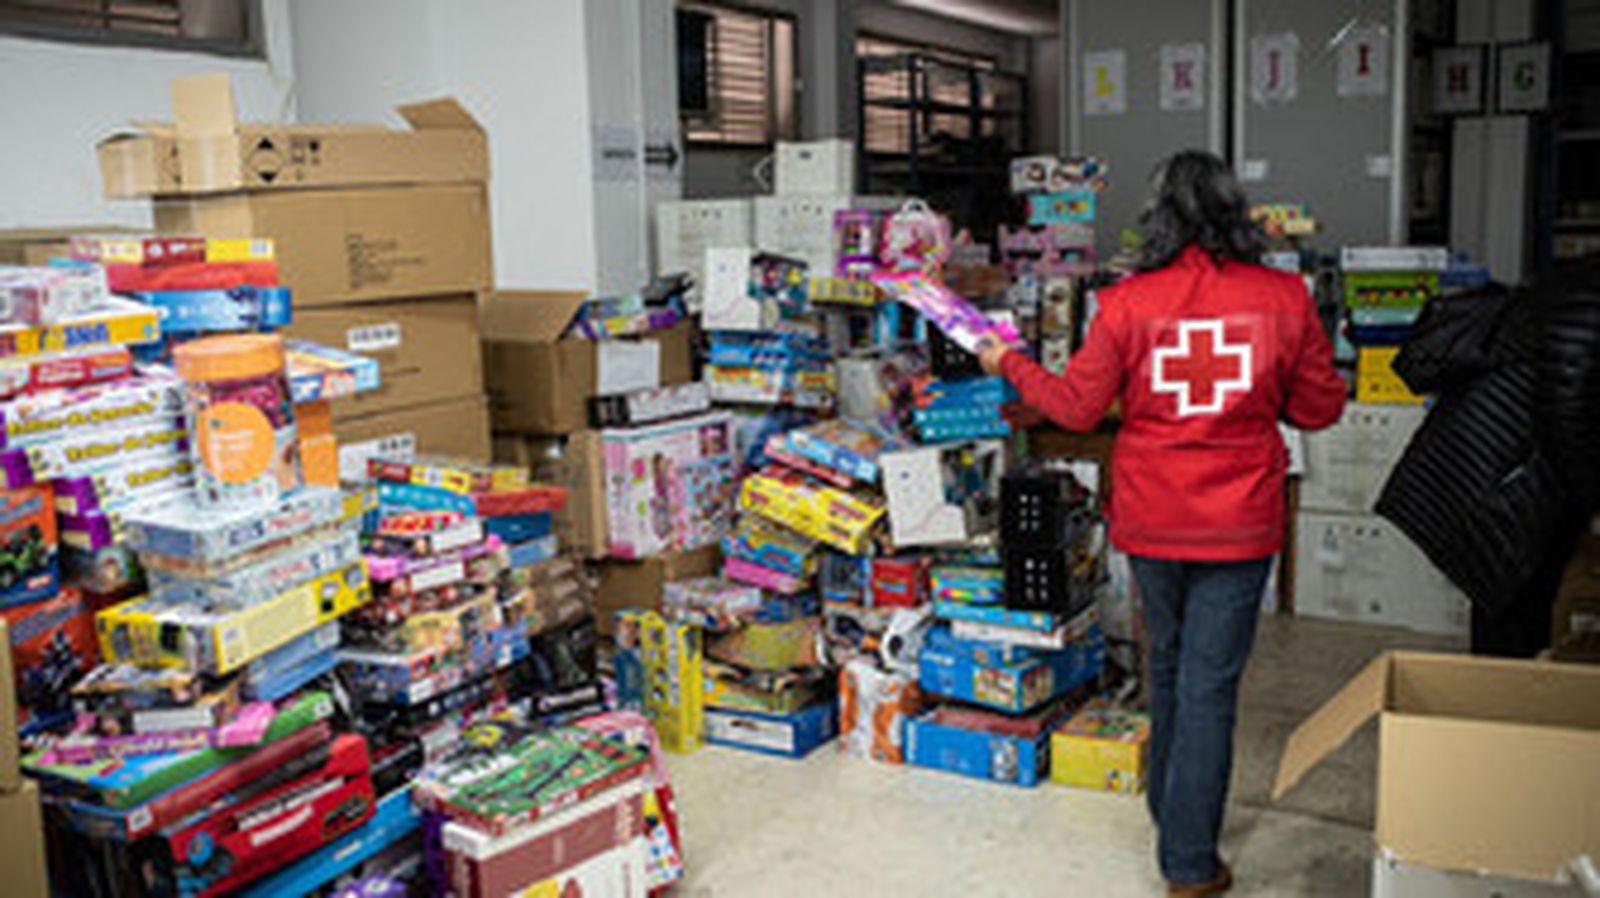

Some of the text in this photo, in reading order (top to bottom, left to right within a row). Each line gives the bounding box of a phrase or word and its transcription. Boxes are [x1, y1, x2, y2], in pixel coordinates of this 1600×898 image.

[1173, 61, 1195, 90] K
[1267, 50, 1281, 91] J
[1356, 43, 1370, 77] I
[1095, 65, 1115, 97] L
[1447, 63, 1470, 94] H
[1514, 61, 1536, 91] G
